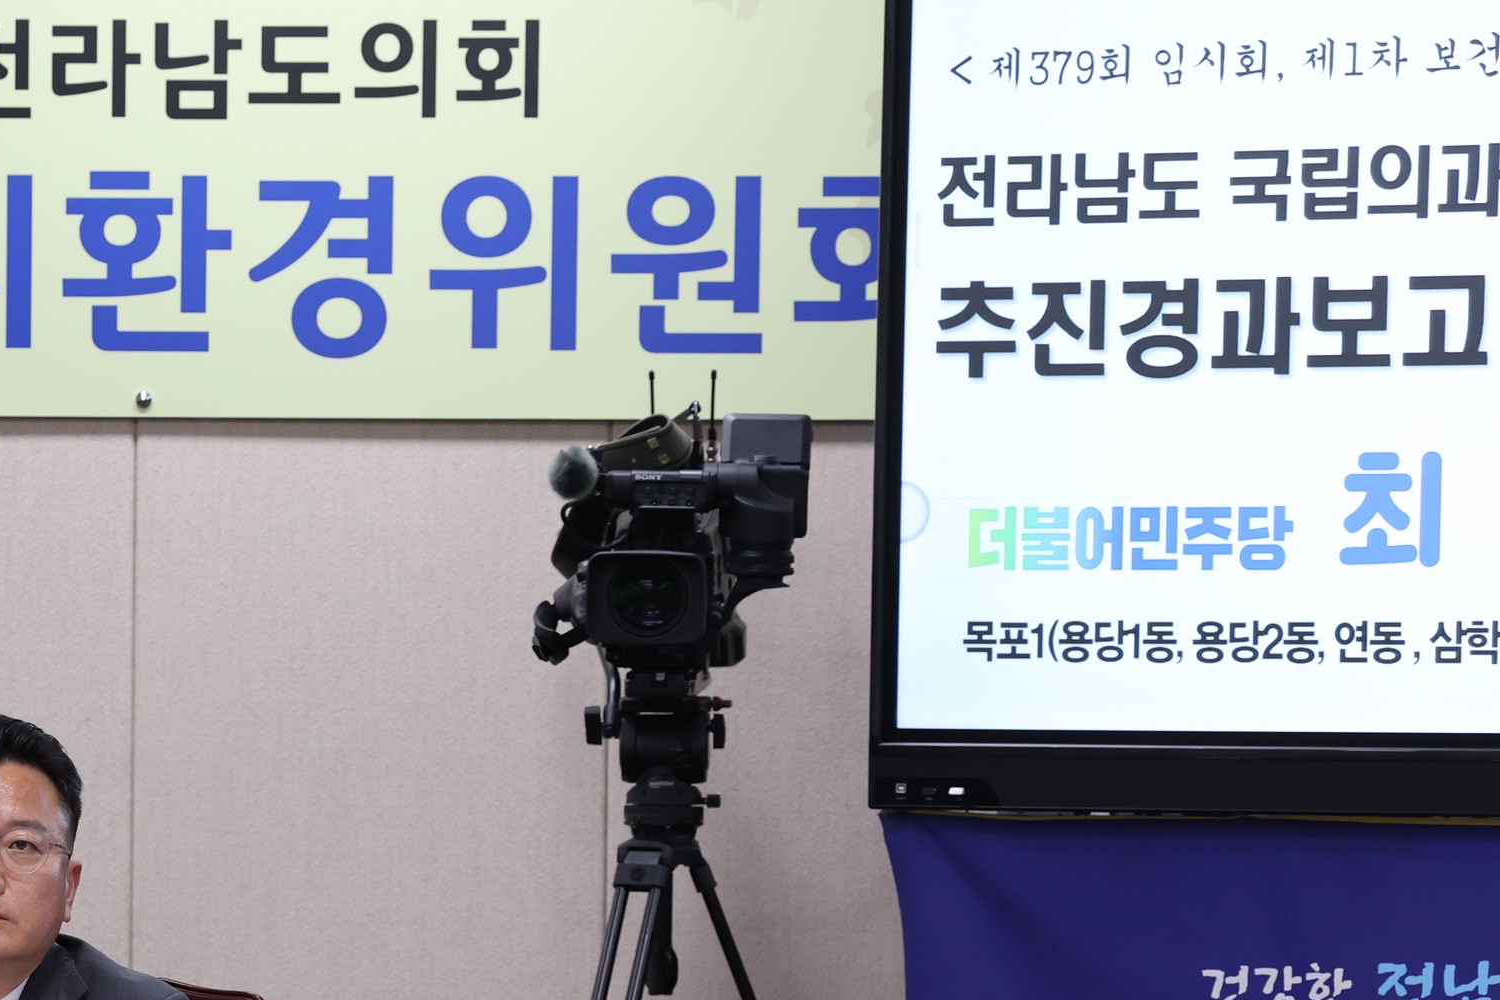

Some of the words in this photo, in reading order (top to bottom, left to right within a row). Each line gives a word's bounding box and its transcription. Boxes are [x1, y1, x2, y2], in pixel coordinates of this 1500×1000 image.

[989, 43, 1131, 90] 제379회
[1155, 39, 1285, 88] 임시회,
[1303, 35, 1409, 81] 제1차
[937, 151, 1200, 227] 전라남도
[936, 275, 1488, 378] 추진경과보고
[968, 505, 1294, 571] 더불어민주당
[1339, 451, 1443, 568] 최
[1192, 620, 1325, 664] 용당2동,
